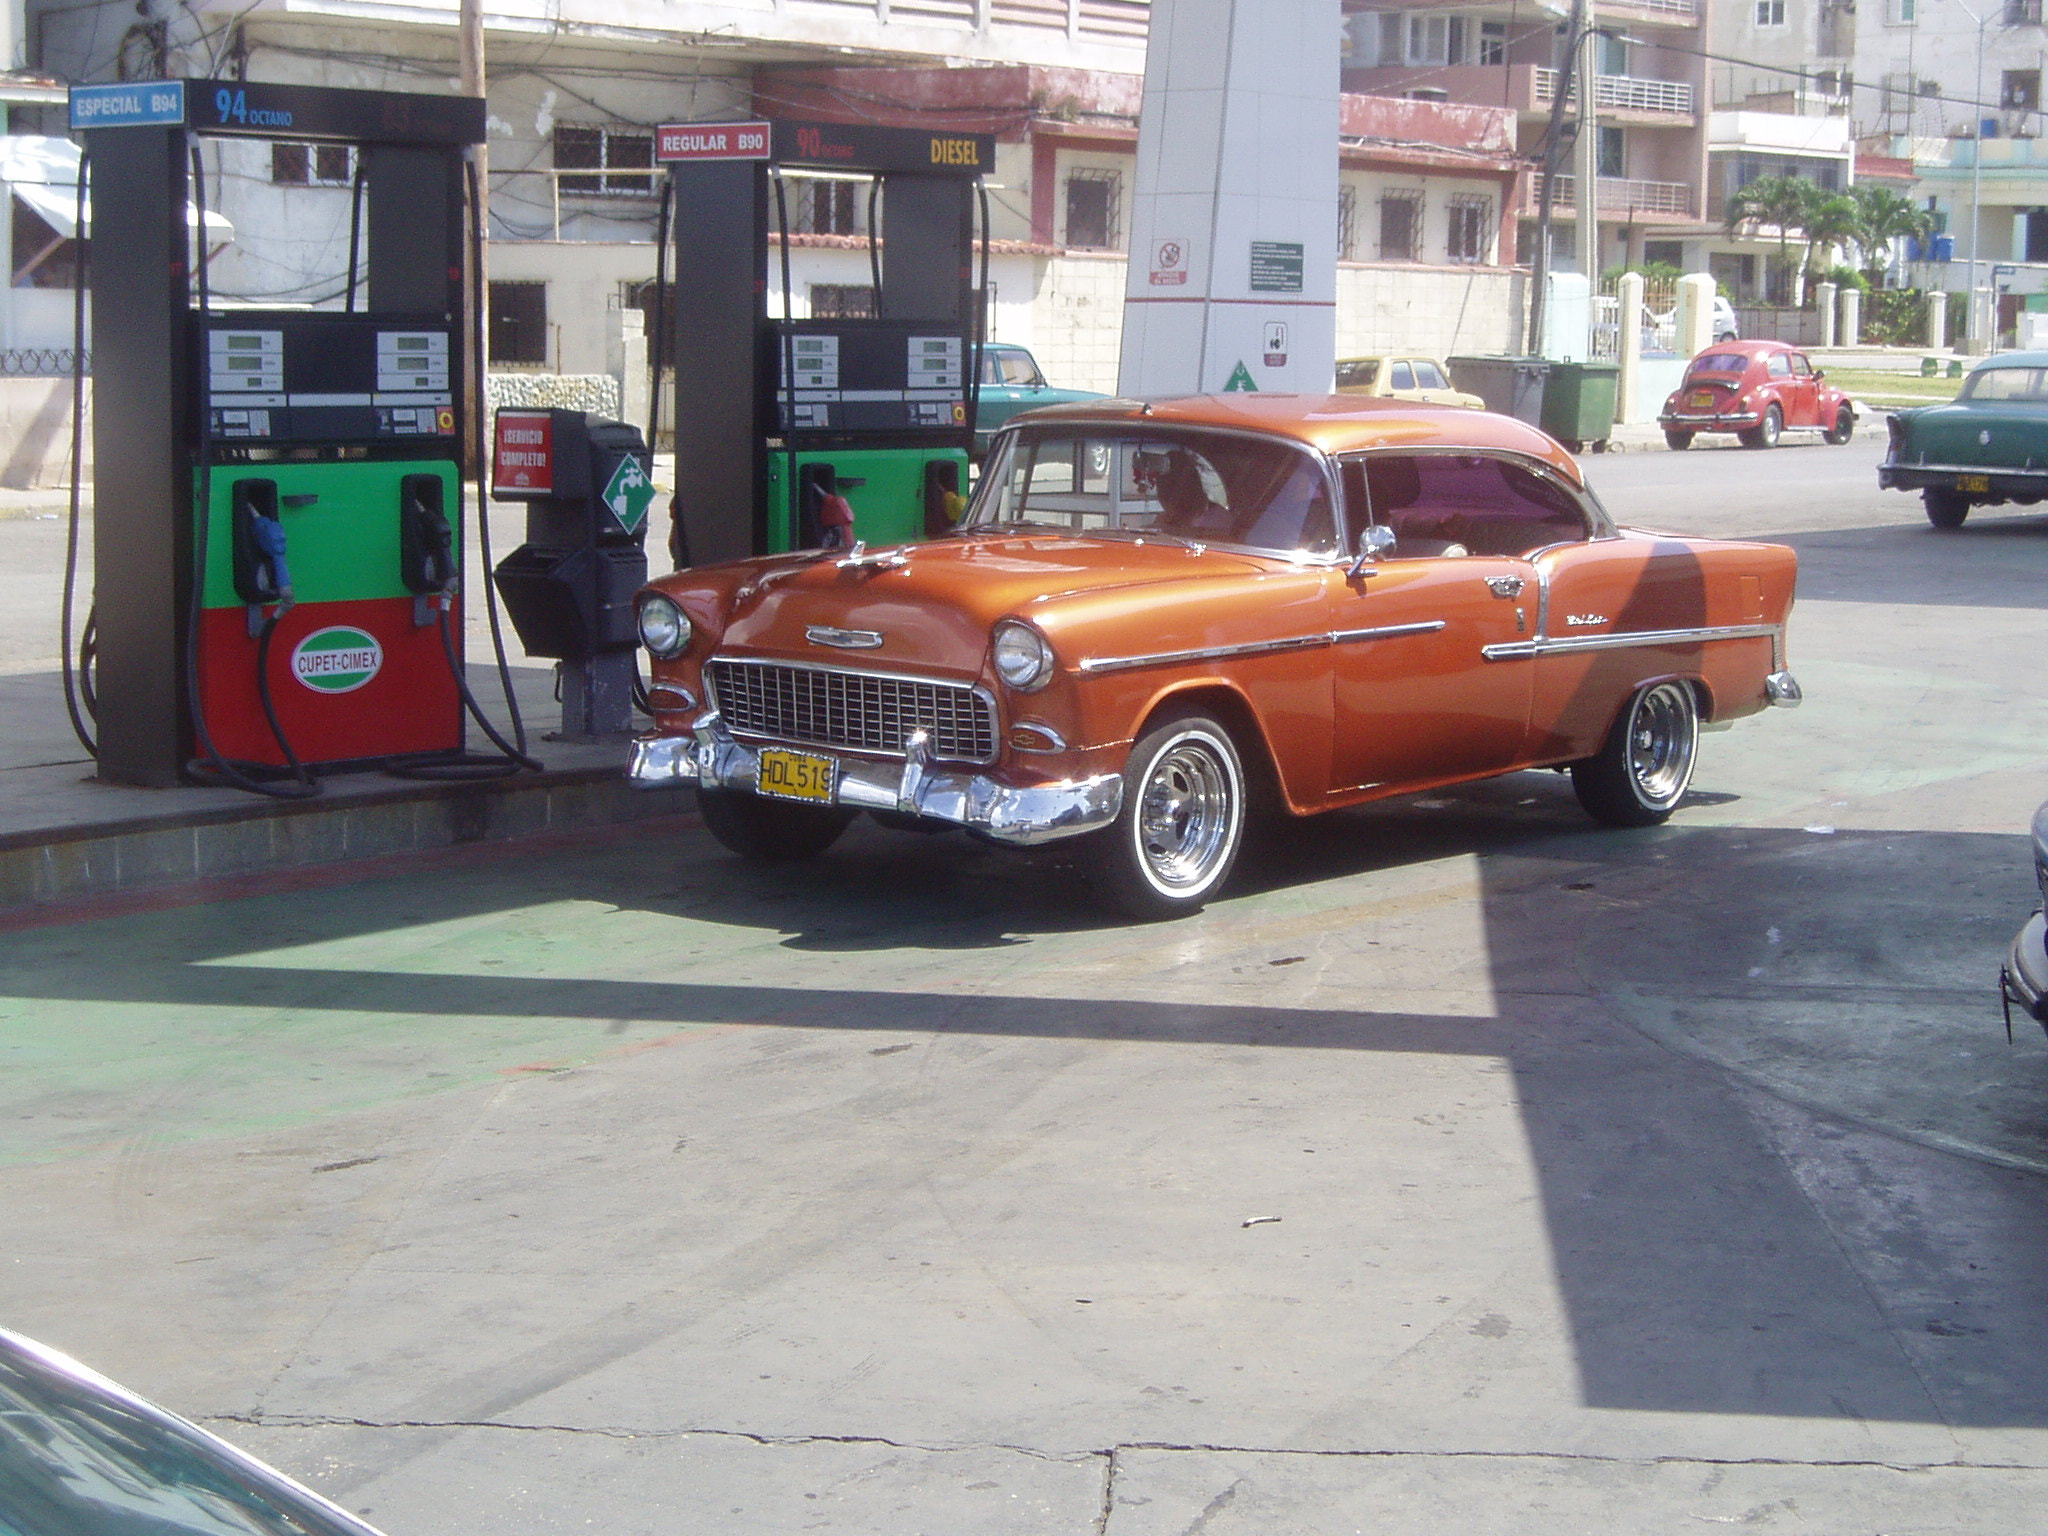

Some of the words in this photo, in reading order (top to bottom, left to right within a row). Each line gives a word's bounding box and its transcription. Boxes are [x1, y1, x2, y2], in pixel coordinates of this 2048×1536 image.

[76, 98, 142, 117] ESPECIAL
[151, 94, 178, 113] B94
[216, 88, 246, 124] 94
[249, 109, 293, 127] OCTANO
[662, 134, 727, 152] REGULAR
[738, 132, 763, 150] B90
[797, 127, 821, 158] 90
[930, 138, 980, 165] DIESEL
[501, 452, 546, 467] COMPLETO!
[298, 652, 377, 673] CUPET-CIMEX
